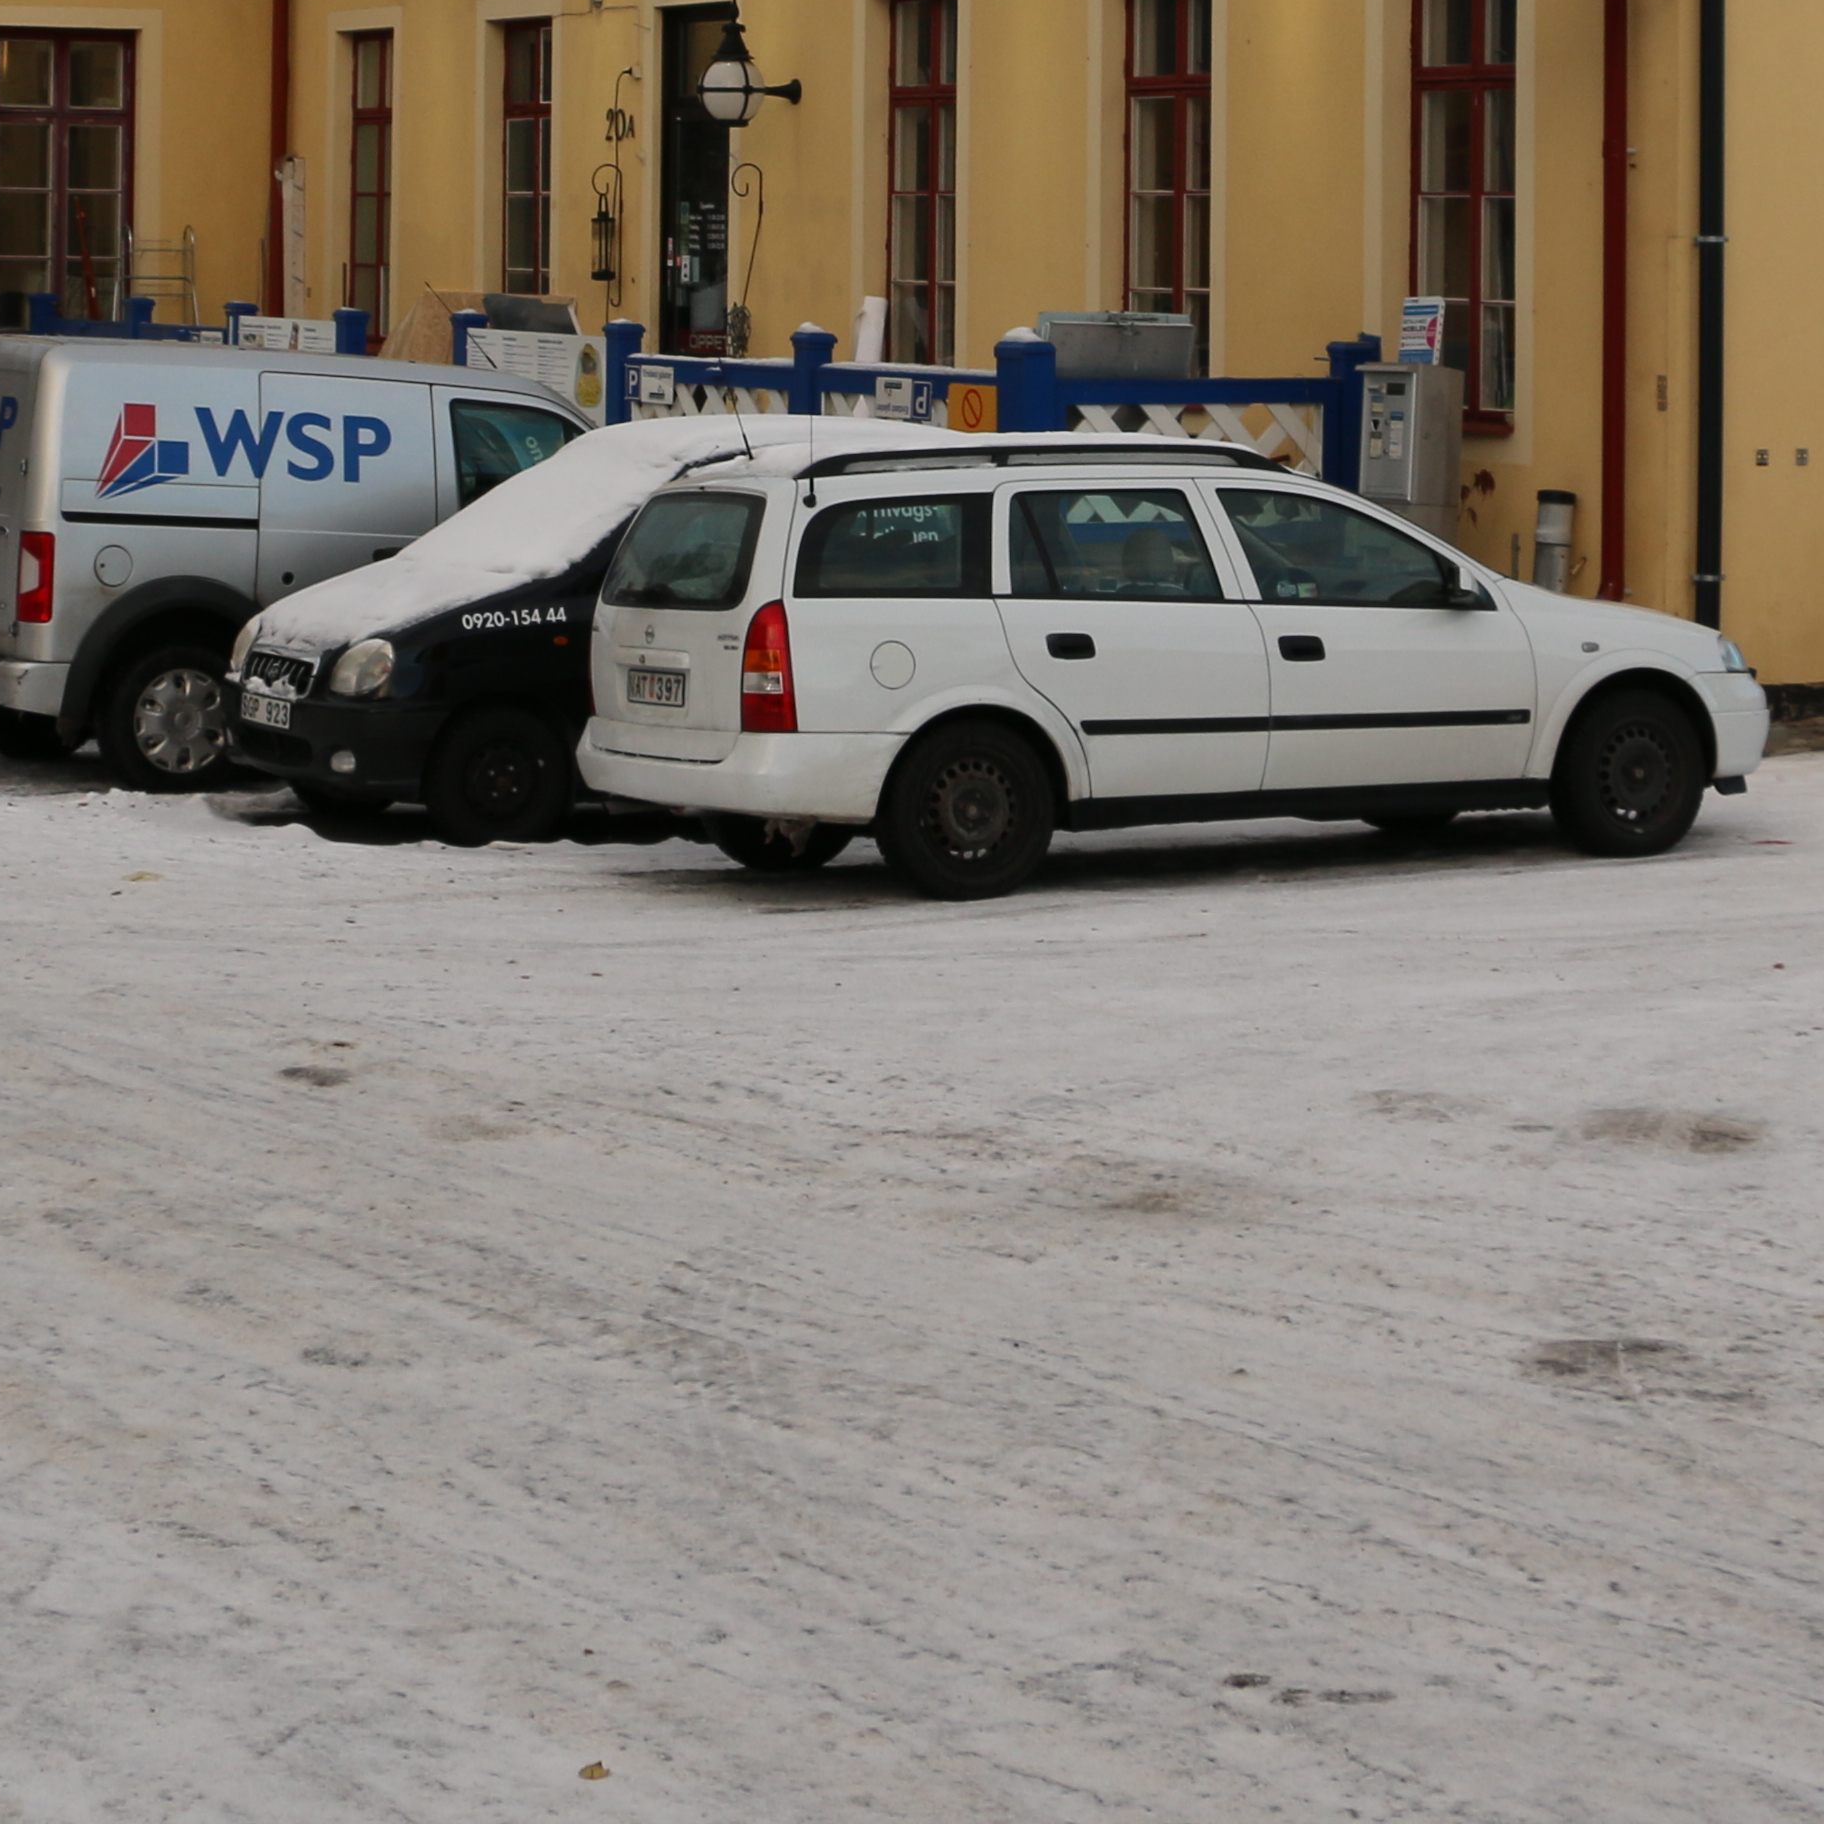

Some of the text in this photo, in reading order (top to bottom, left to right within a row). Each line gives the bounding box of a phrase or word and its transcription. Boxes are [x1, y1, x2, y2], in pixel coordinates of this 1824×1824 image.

[628, 369, 639, 395] P
[194, 406, 392, 483] WSP
[462, 607, 567, 630] 0920-154 44
[655, 676, 682, 702] 397
[265, 700, 289, 727] 923
